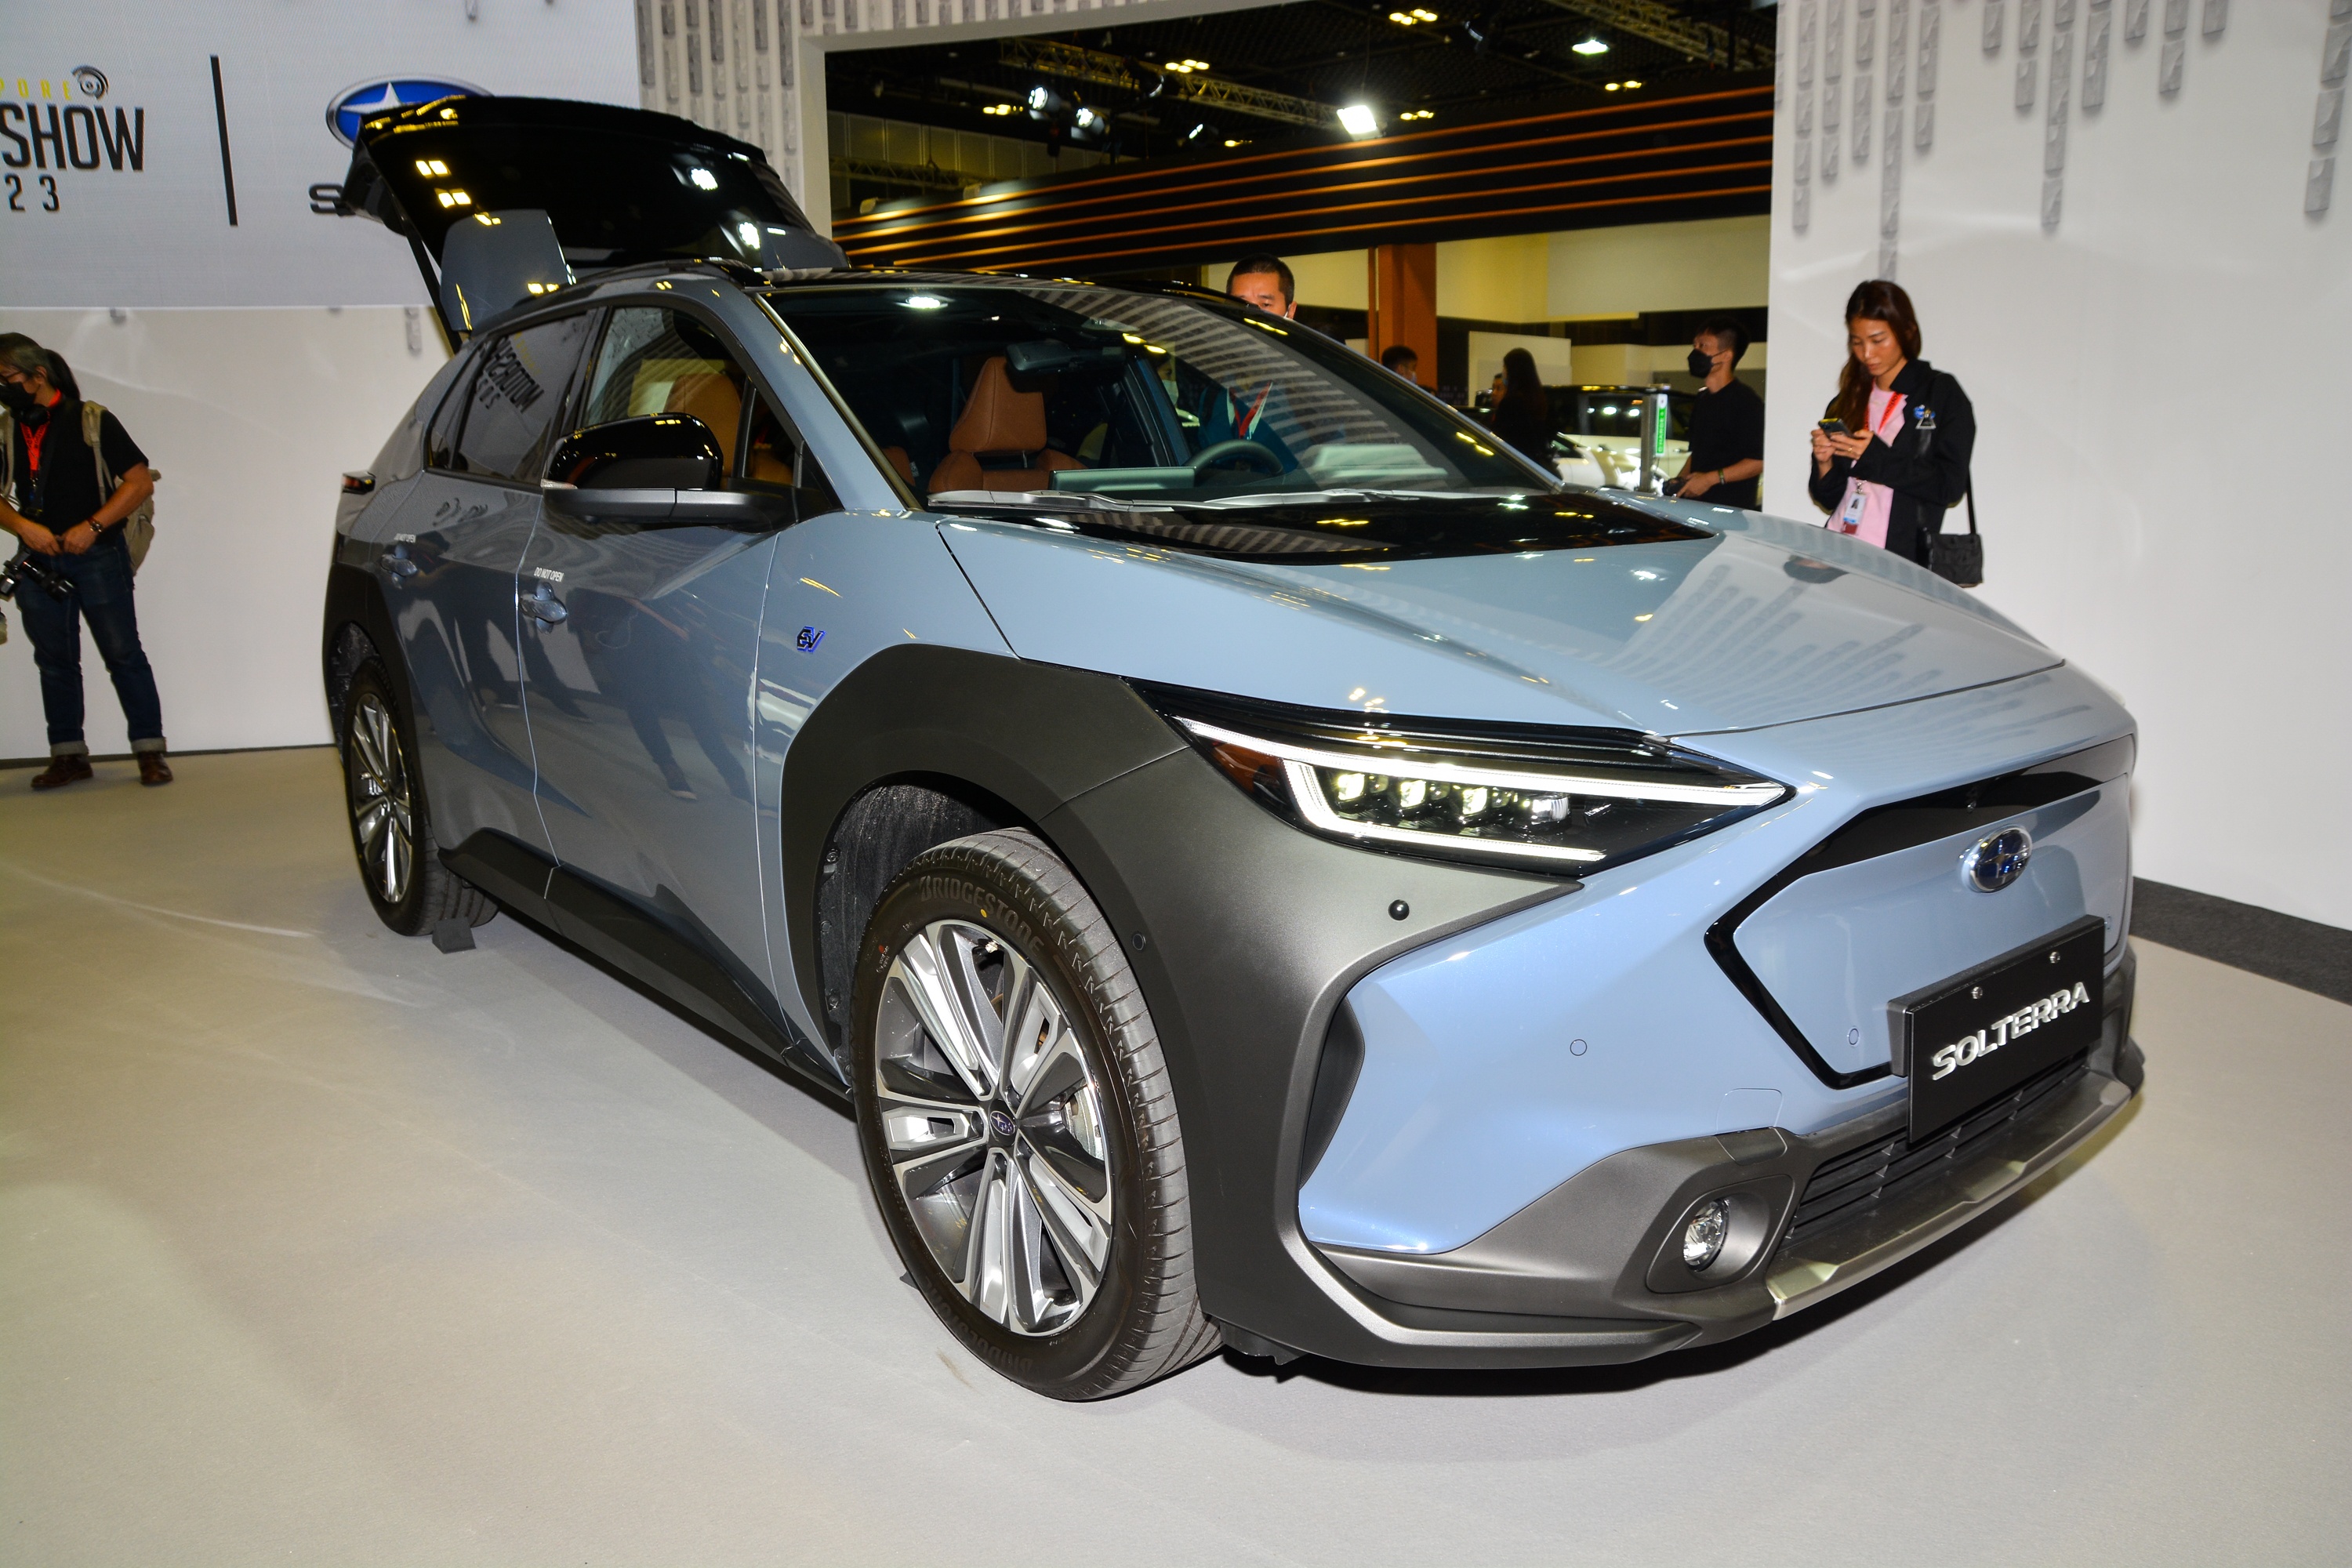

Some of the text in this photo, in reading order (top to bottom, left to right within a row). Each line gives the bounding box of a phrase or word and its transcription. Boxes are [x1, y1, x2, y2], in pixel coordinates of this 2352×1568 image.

[0, 78, 71, 101] ORE
[0, 102, 145, 172] SHOW
[534, 567, 564, 582] DO NOT OPEN
[919, 875, 1044, 956] BRIDGESTONE
[1933, 982, 2090, 1080] SOLTERRA
